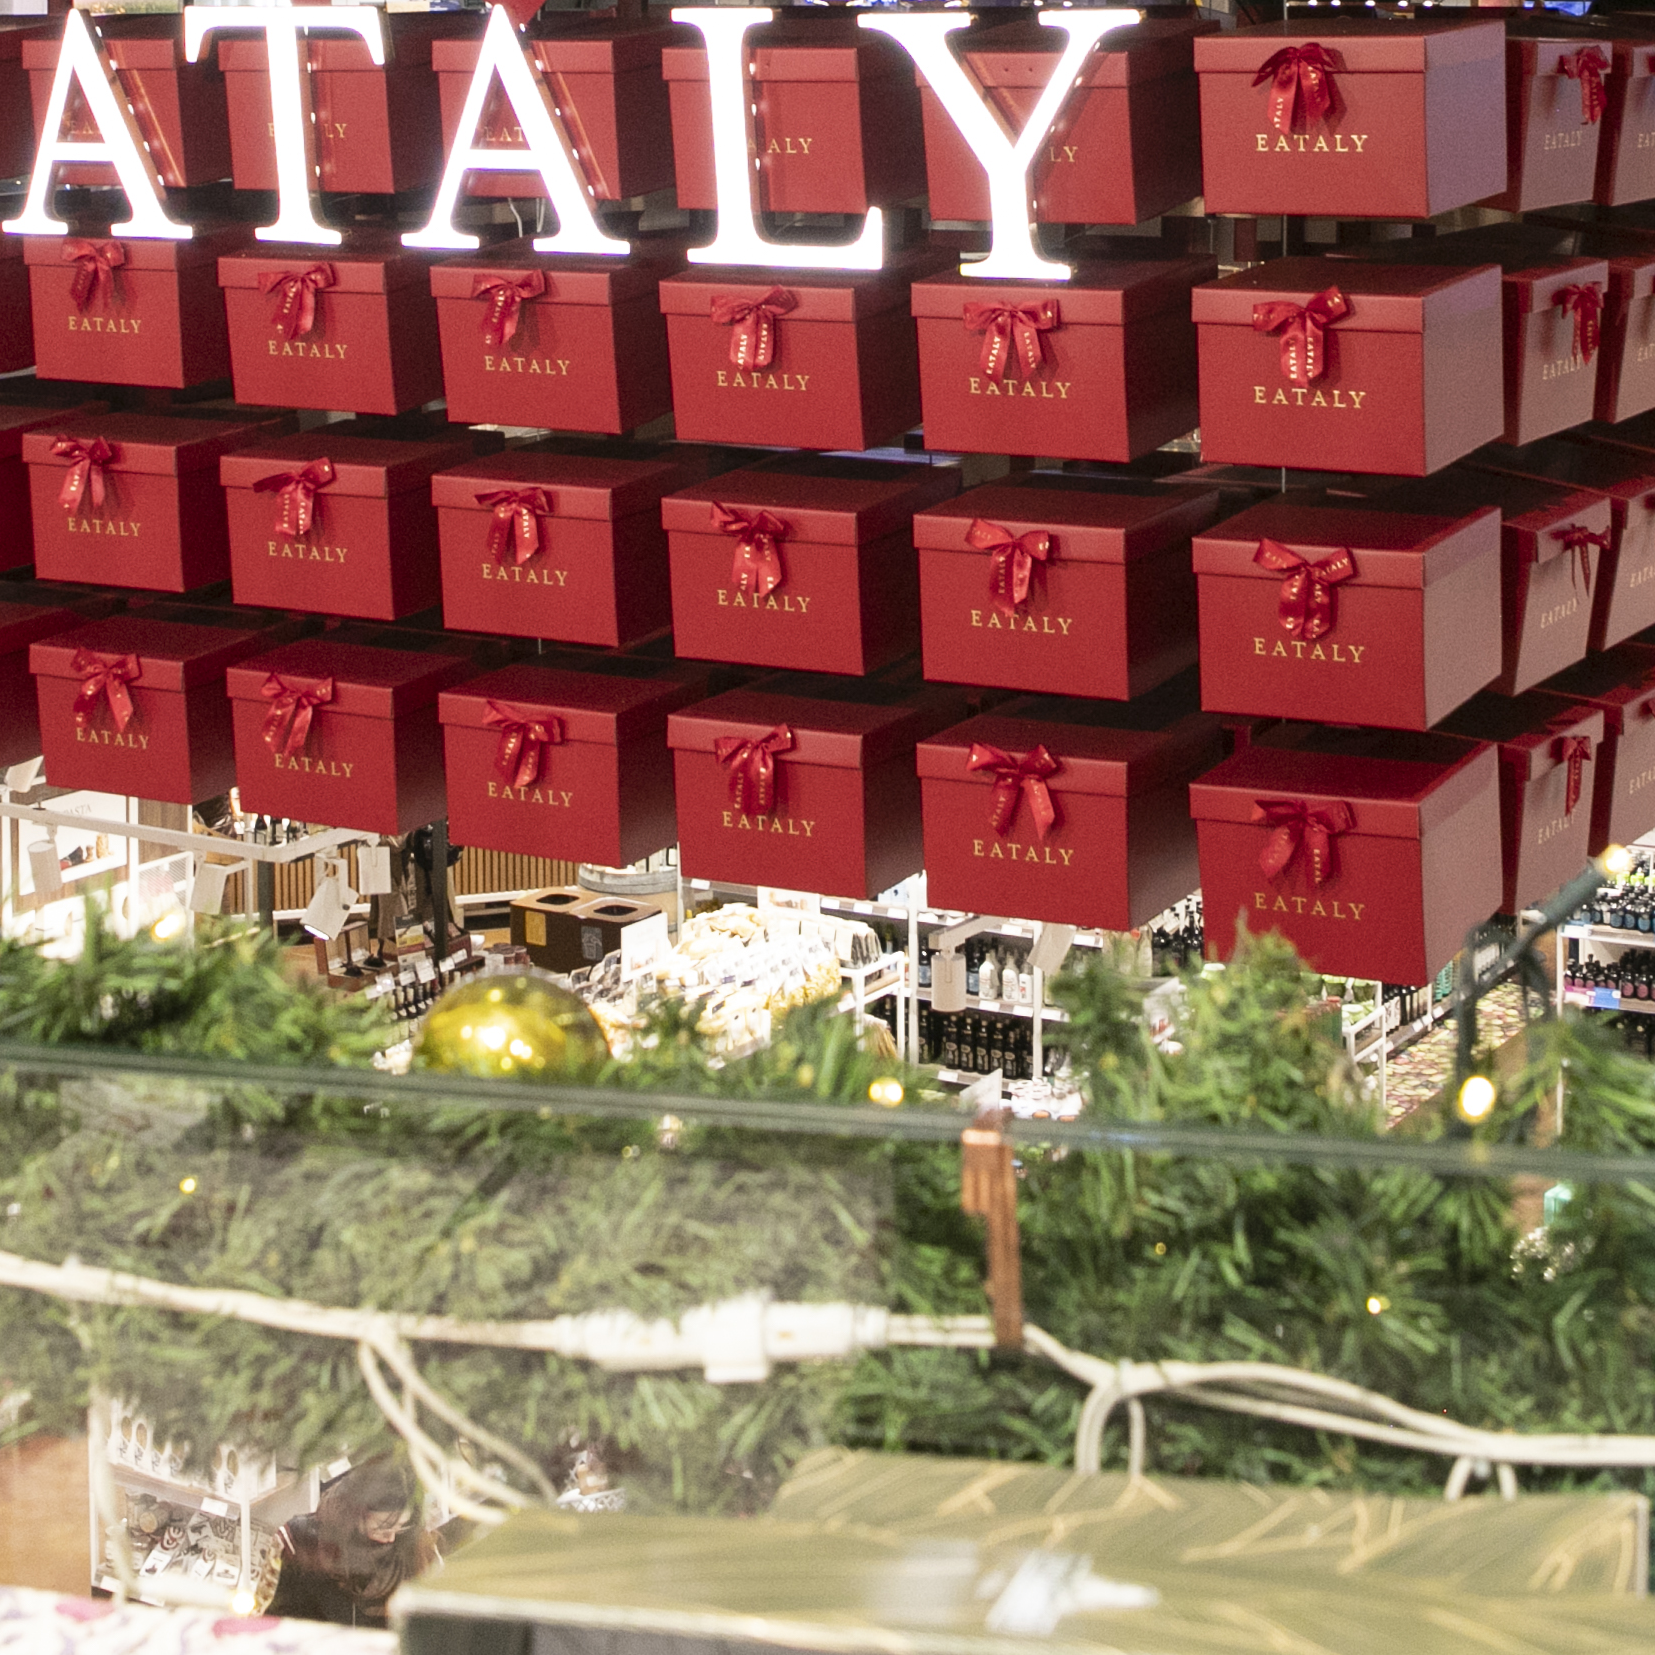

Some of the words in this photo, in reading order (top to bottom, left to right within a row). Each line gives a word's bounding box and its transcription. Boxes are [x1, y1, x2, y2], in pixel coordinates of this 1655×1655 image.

[1255, 133, 1369, 153] EATALY
[68, 315, 143, 334] EATALY
[268, 339, 349, 360] EATALY
[484, 355, 571, 376] EATALY
[716, 370, 811, 391] EATALY
[969, 376, 1072, 399] EATALY
[1253, 385, 1367, 409] EATALY
[67, 516, 142, 537] EATALY
[267, 540, 349, 563] EATALY
[481, 563, 569, 587] EATALY
[717, 589, 812, 613] EATALY
[970, 609, 1074, 635] EATALY
[1253, 637, 1366, 664] EATALY
[76, 726, 150, 750] EATALY
[274, 753, 355, 778] EATALY
[487, 781, 574, 808] EATALY
[722, 810, 816, 837] EATALY
[973, 839, 1075, 866] EATALY
[1254, 892, 1366, 920] EATALY
